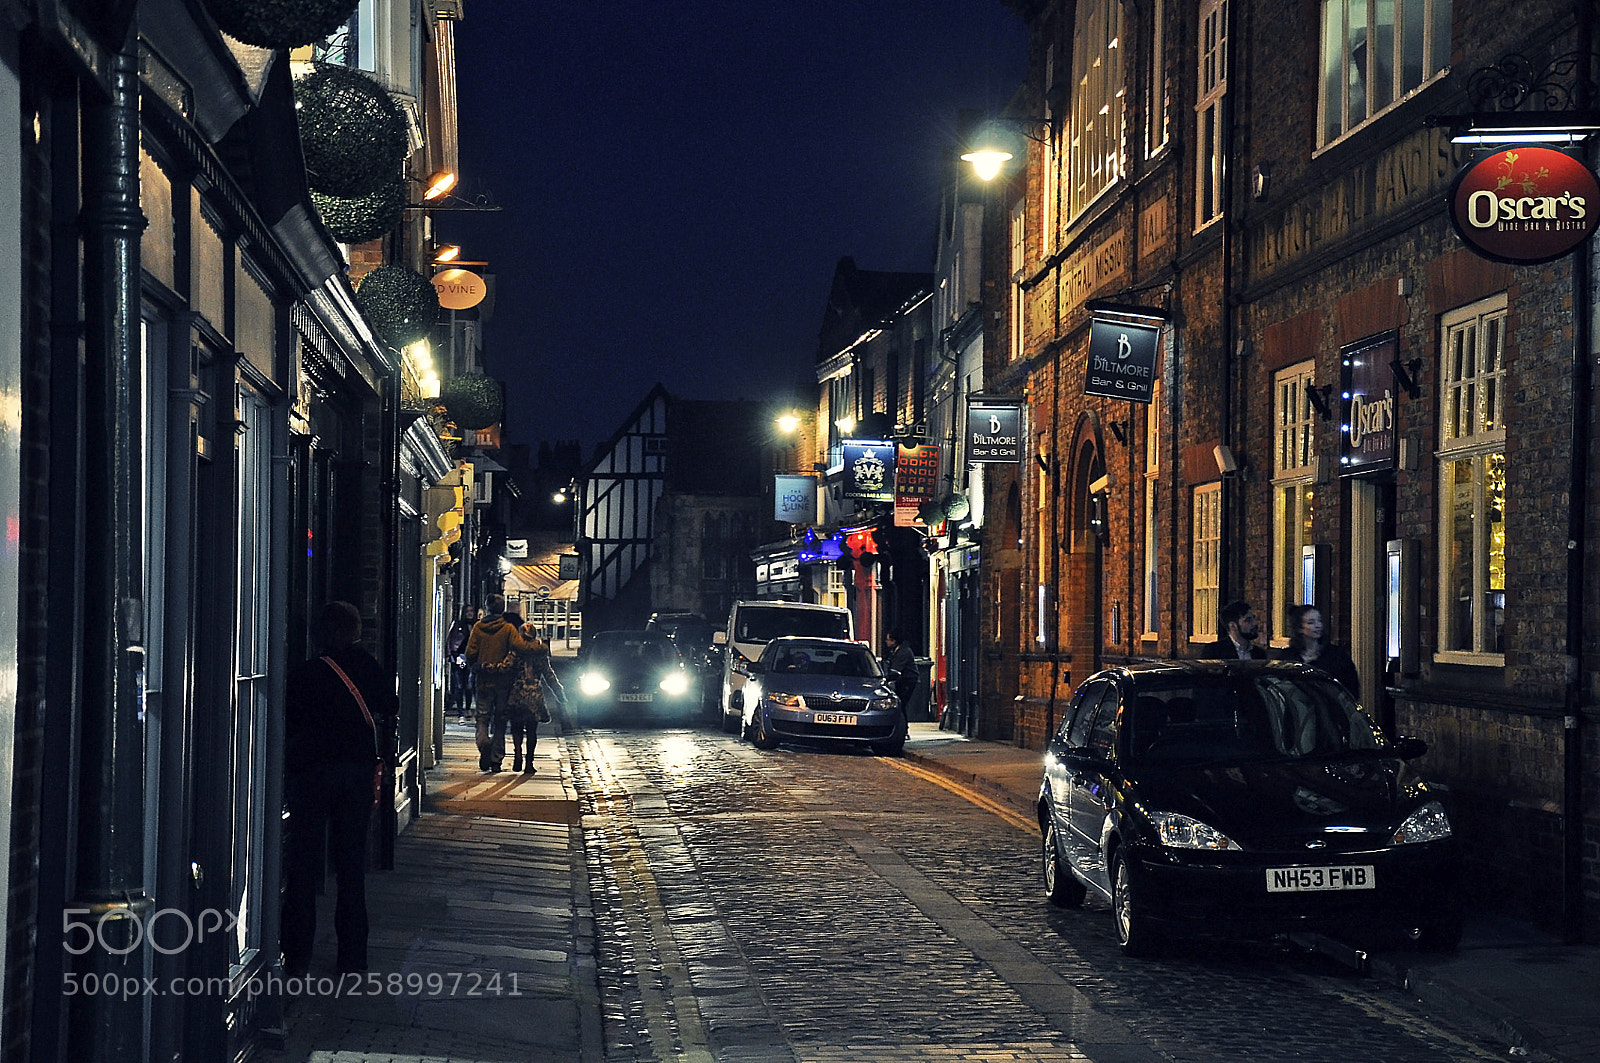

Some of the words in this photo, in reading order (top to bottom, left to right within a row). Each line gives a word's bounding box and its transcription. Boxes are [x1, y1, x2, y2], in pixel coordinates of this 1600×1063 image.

[1468, 190, 1586, 228] Oscar's
[1545, 222, 1550, 231] &
[1095, 237, 1124, 282] MISSIO
[449, 285, 476, 294] VINE
[1091, 376, 1112, 387] Bar
[1115, 379, 1125, 389] &
[1127, 381, 1148, 392] Grill
[1350, 389, 1393, 448] Oscar's
[973, 448, 989, 456] Bar
[990, 448, 998, 456] &
[999, 448, 1016, 456] Grill
[782, 494, 808, 503] HOOK
[1274, 869, 1324, 888] NH53
[1328, 868, 1367, 887] FWB
